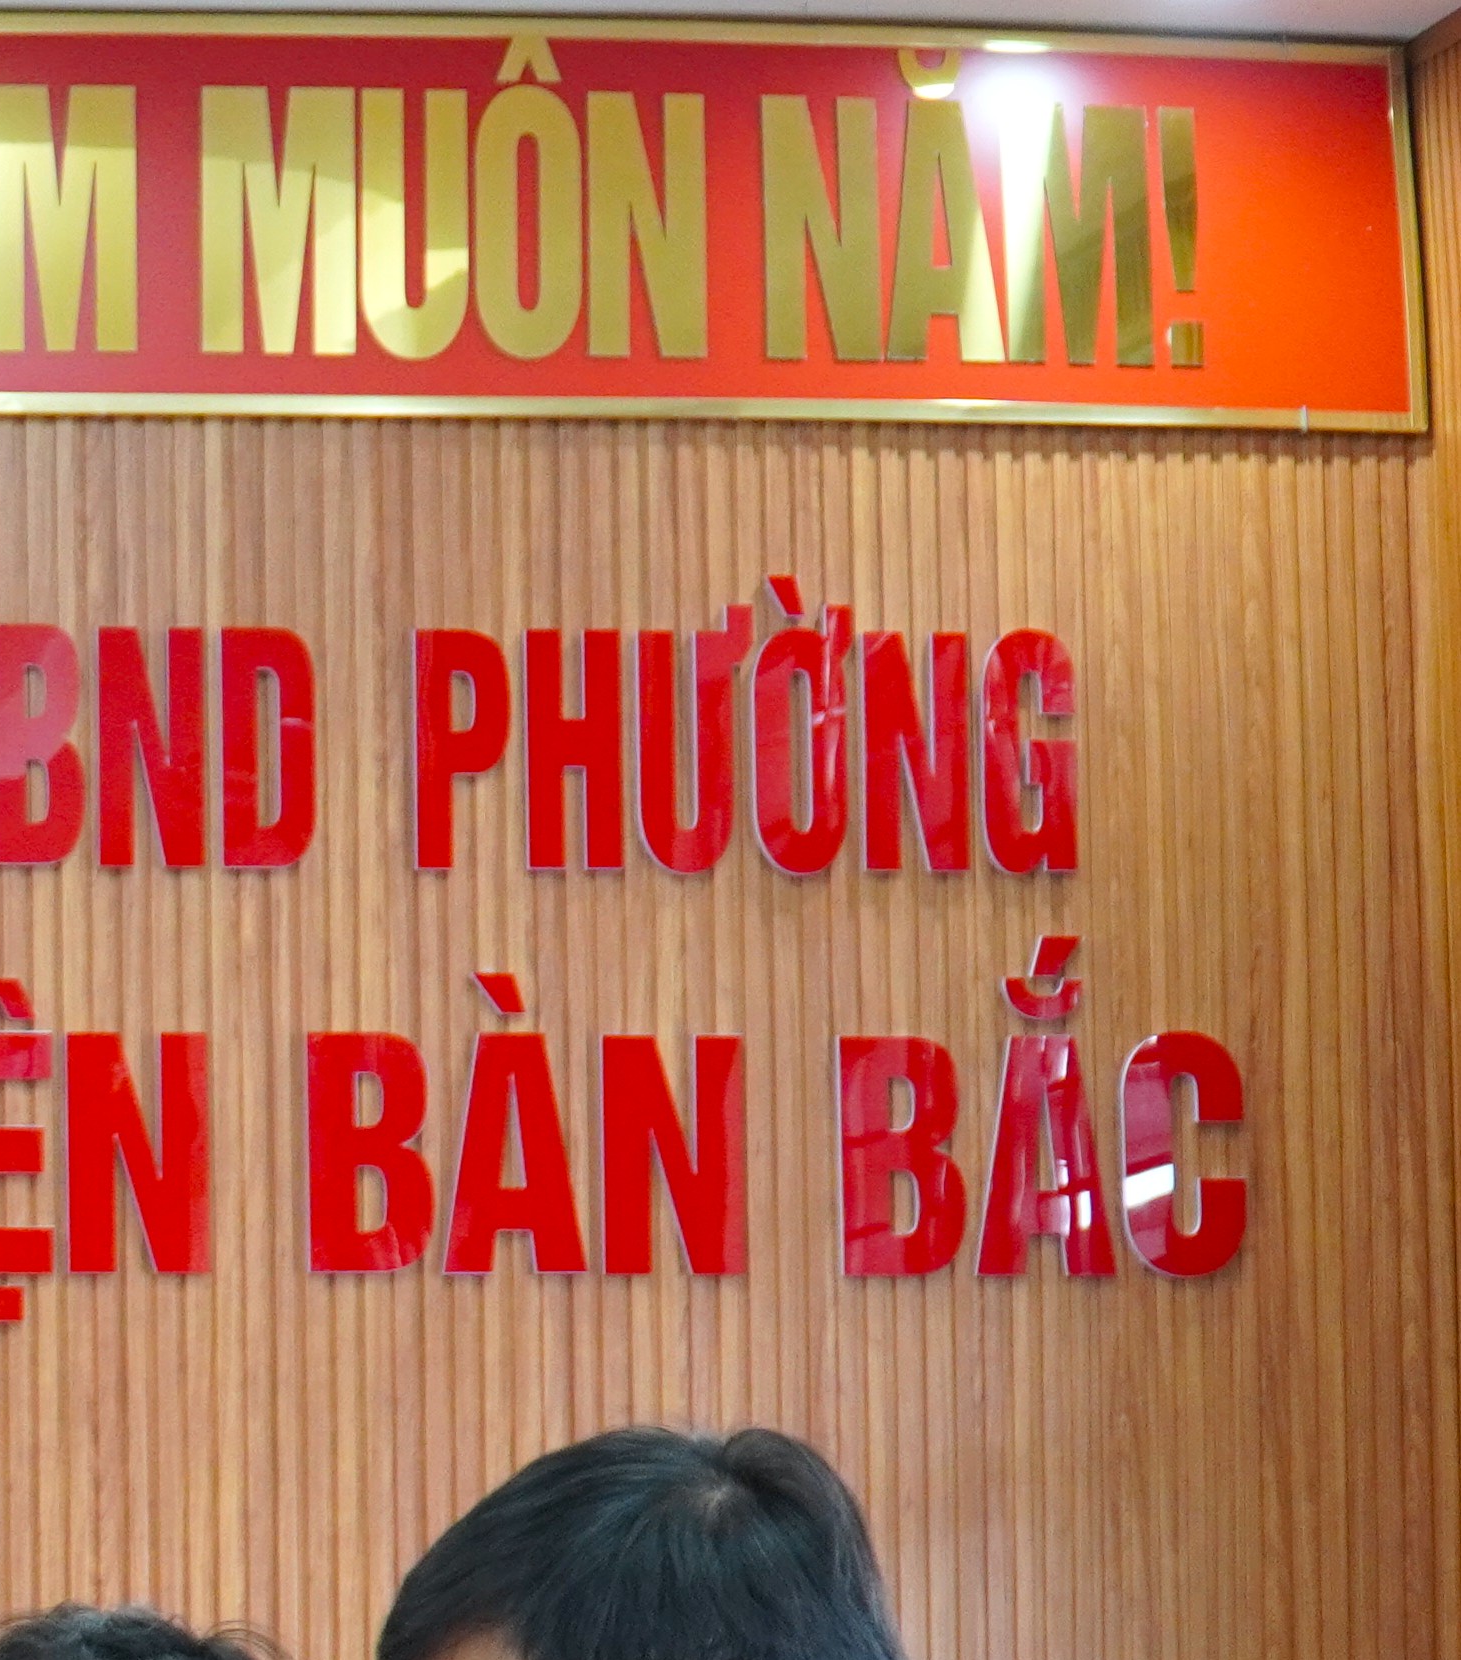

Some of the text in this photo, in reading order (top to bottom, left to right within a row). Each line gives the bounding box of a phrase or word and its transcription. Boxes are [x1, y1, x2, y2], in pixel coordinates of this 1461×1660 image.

[200, 36, 709, 360] MUÔN
[760, 48, 1205, 368] NĂM!
[413, 576, 1081, 876] PHƯỜNG
[307, 972, 745, 1276] BÀN
[839, 935, 1249, 1278] BẮC
